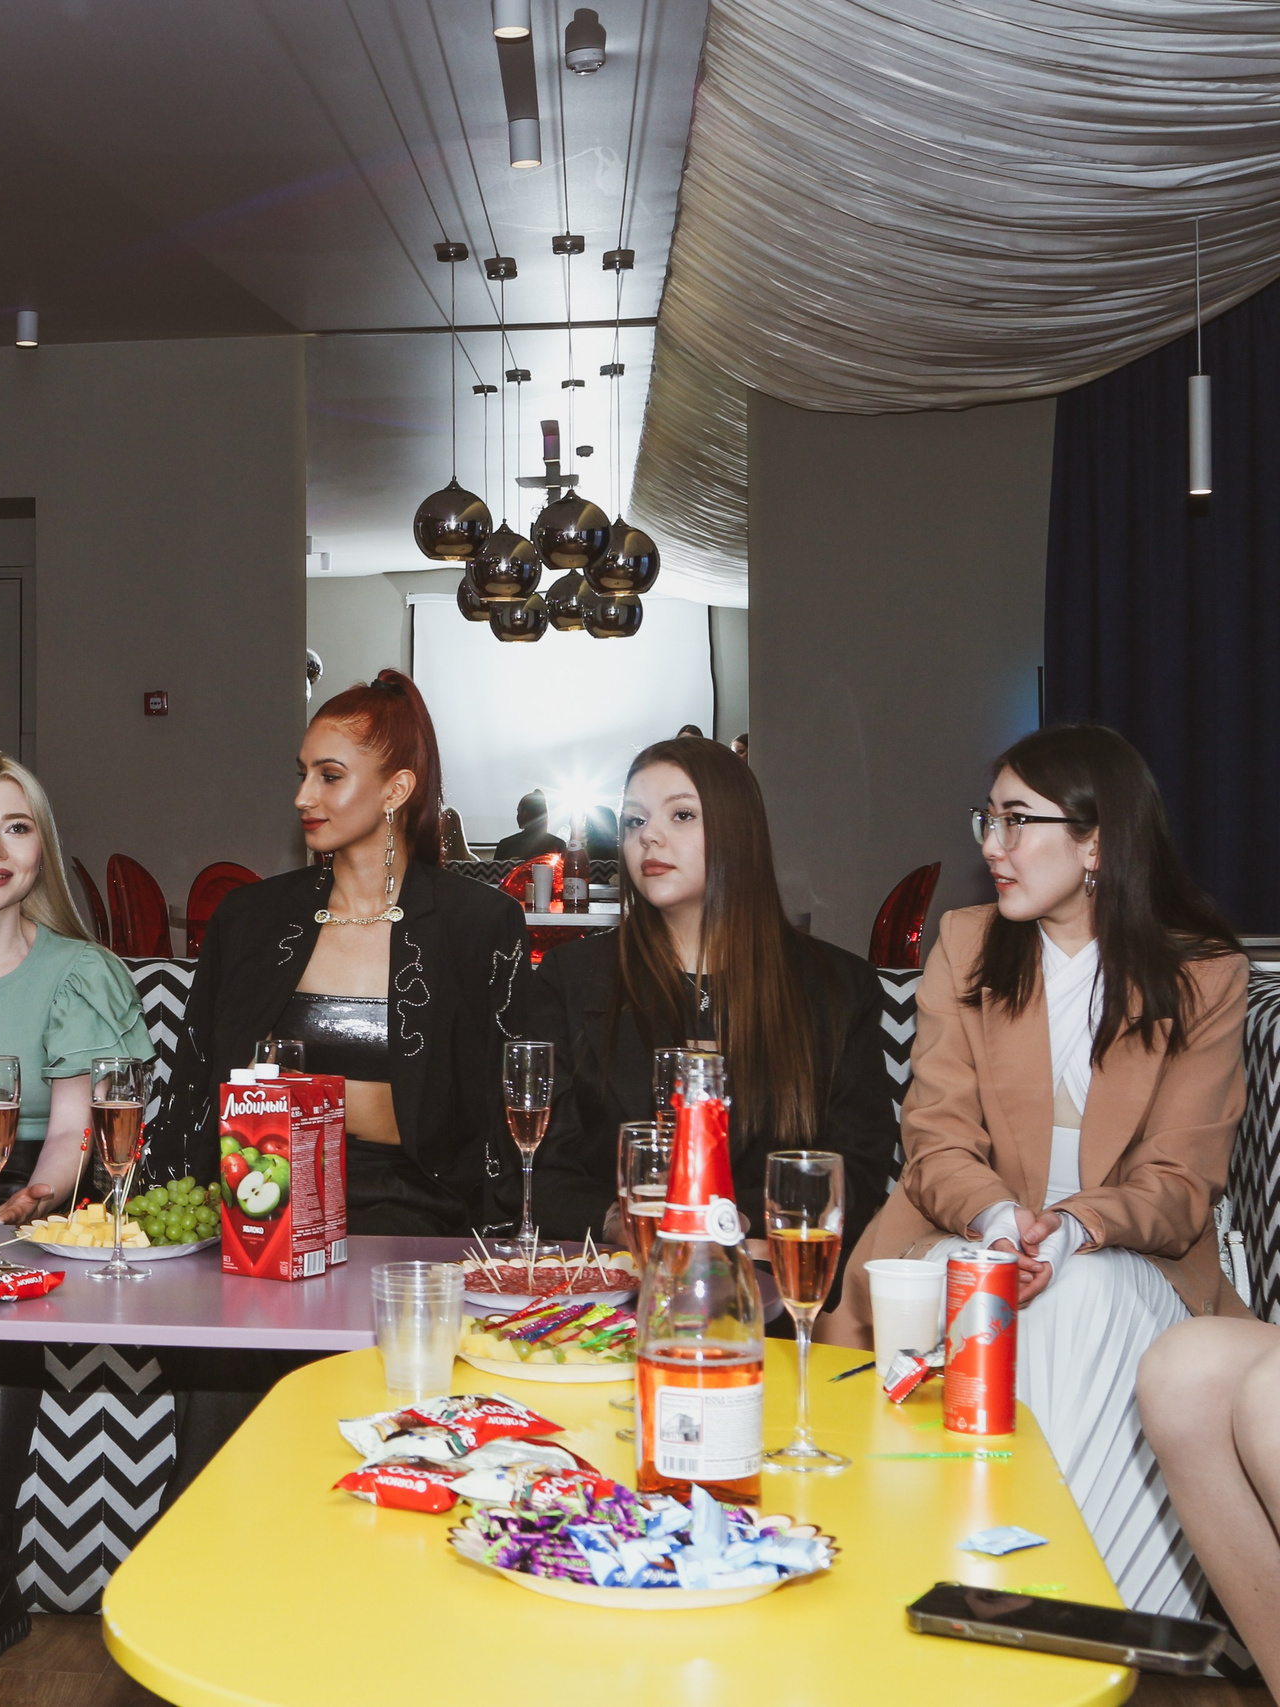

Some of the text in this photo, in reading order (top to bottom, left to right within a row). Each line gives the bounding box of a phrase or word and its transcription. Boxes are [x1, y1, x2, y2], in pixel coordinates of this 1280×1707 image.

[220, 1090, 289, 1120] Любимый
[487, 1416, 518, 1426] ORION
[377, 1475, 414, 1489] ORION
